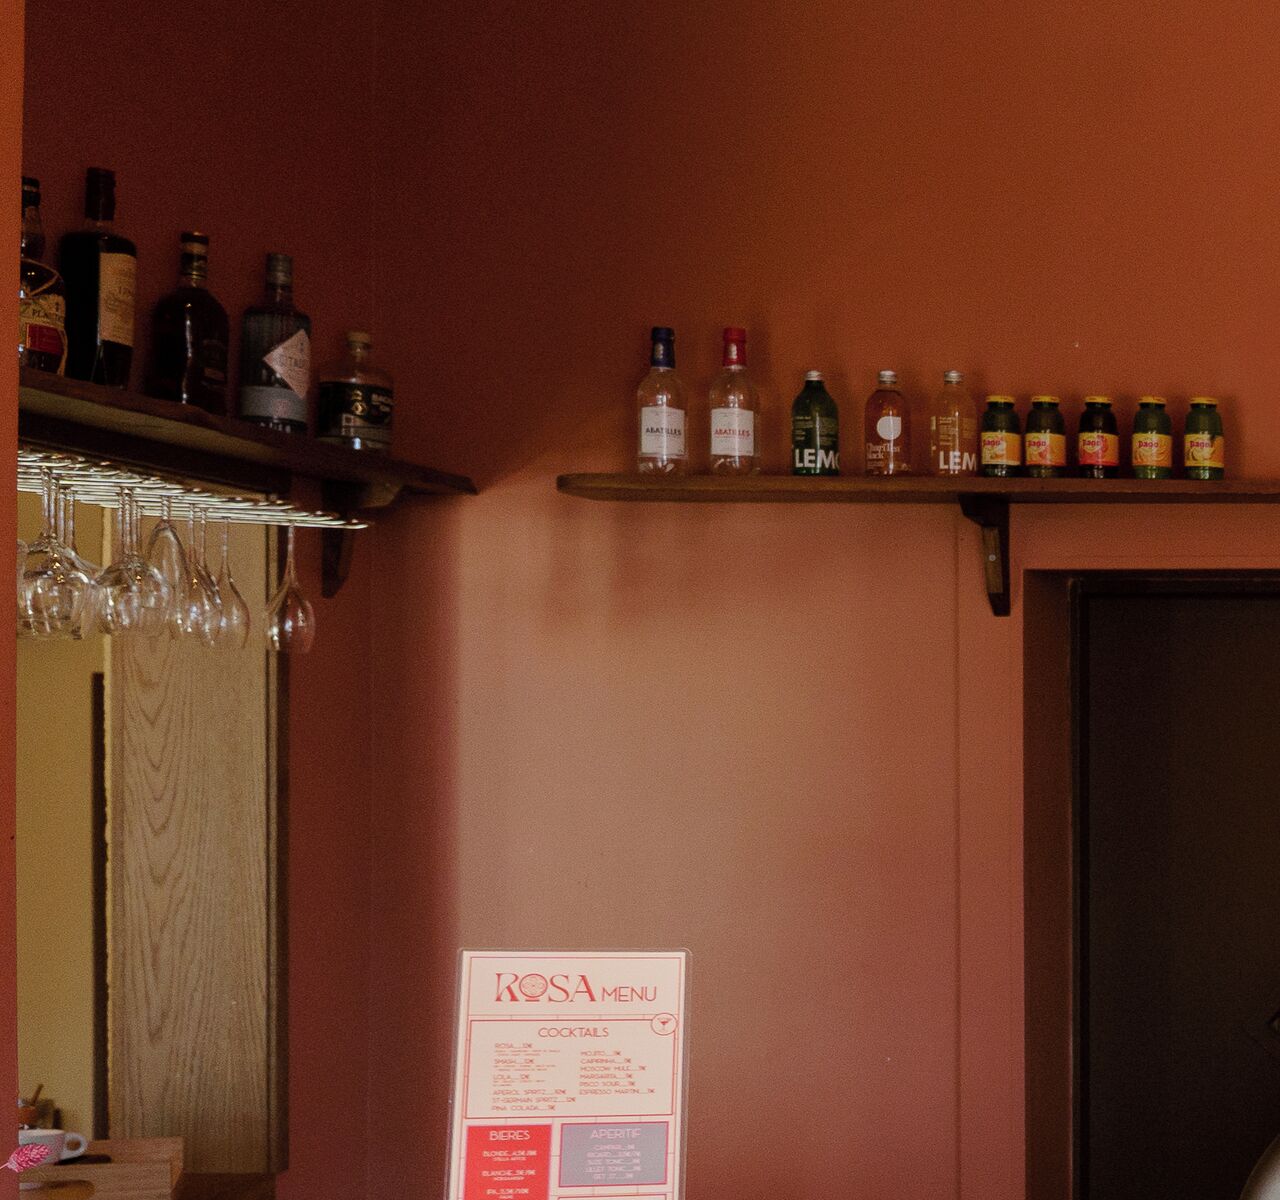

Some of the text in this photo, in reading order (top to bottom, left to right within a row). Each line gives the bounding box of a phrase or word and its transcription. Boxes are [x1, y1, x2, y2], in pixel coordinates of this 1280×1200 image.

[495, 972, 657, 1003] ROSA MENU
[538, 1026, 609, 1038] COCKTAILS
